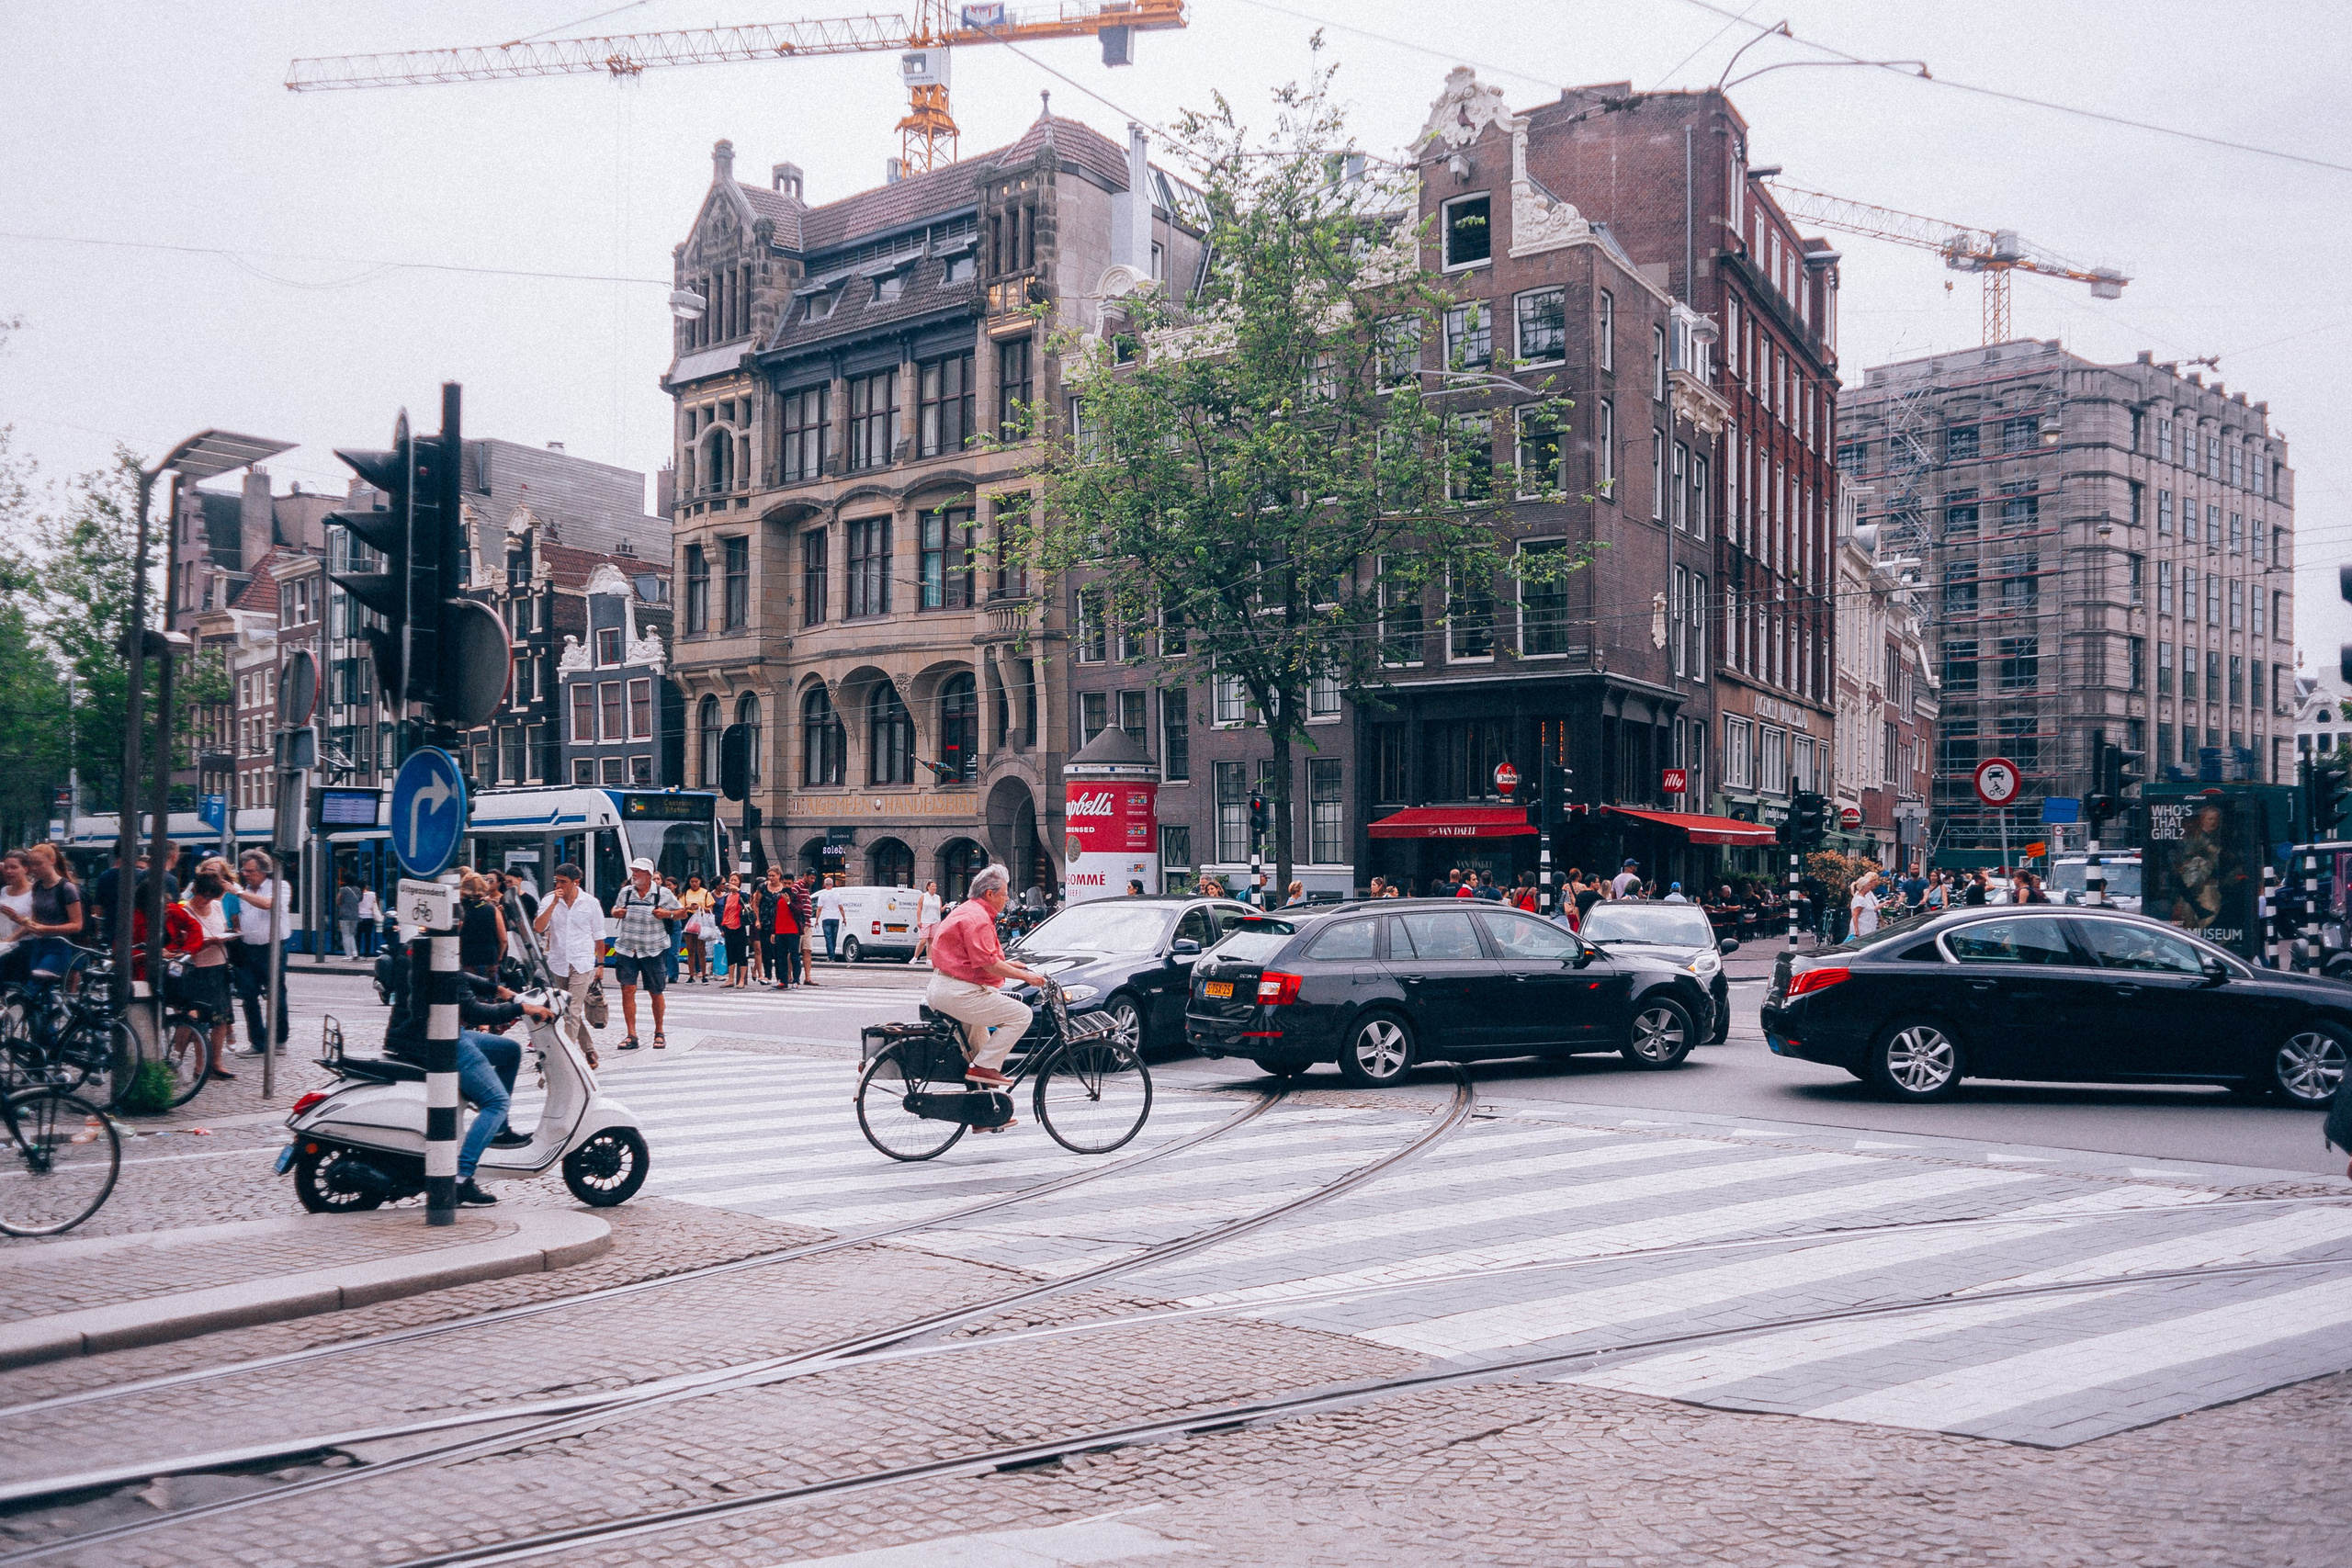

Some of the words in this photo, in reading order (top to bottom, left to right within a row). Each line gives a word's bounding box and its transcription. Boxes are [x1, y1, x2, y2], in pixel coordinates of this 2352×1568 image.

[1664, 773, 1684, 791] illy
[630, 797, 638, 813] 5
[806, 795, 872, 816] ALGEMEEN
[883, 795, 978, 815] HANDELSBLAD
[2151, 805, 2193, 817] WHO'S
[2151, 817, 2184, 828] THAT
[1438, 827, 1452, 835] VAN
[1453, 826, 1476, 835] DAELE
[2151, 828, 2185, 840] GIRL?
[1456, 860, 1469, 868] VAN
[400, 884, 447, 897] Uitgezonderd
